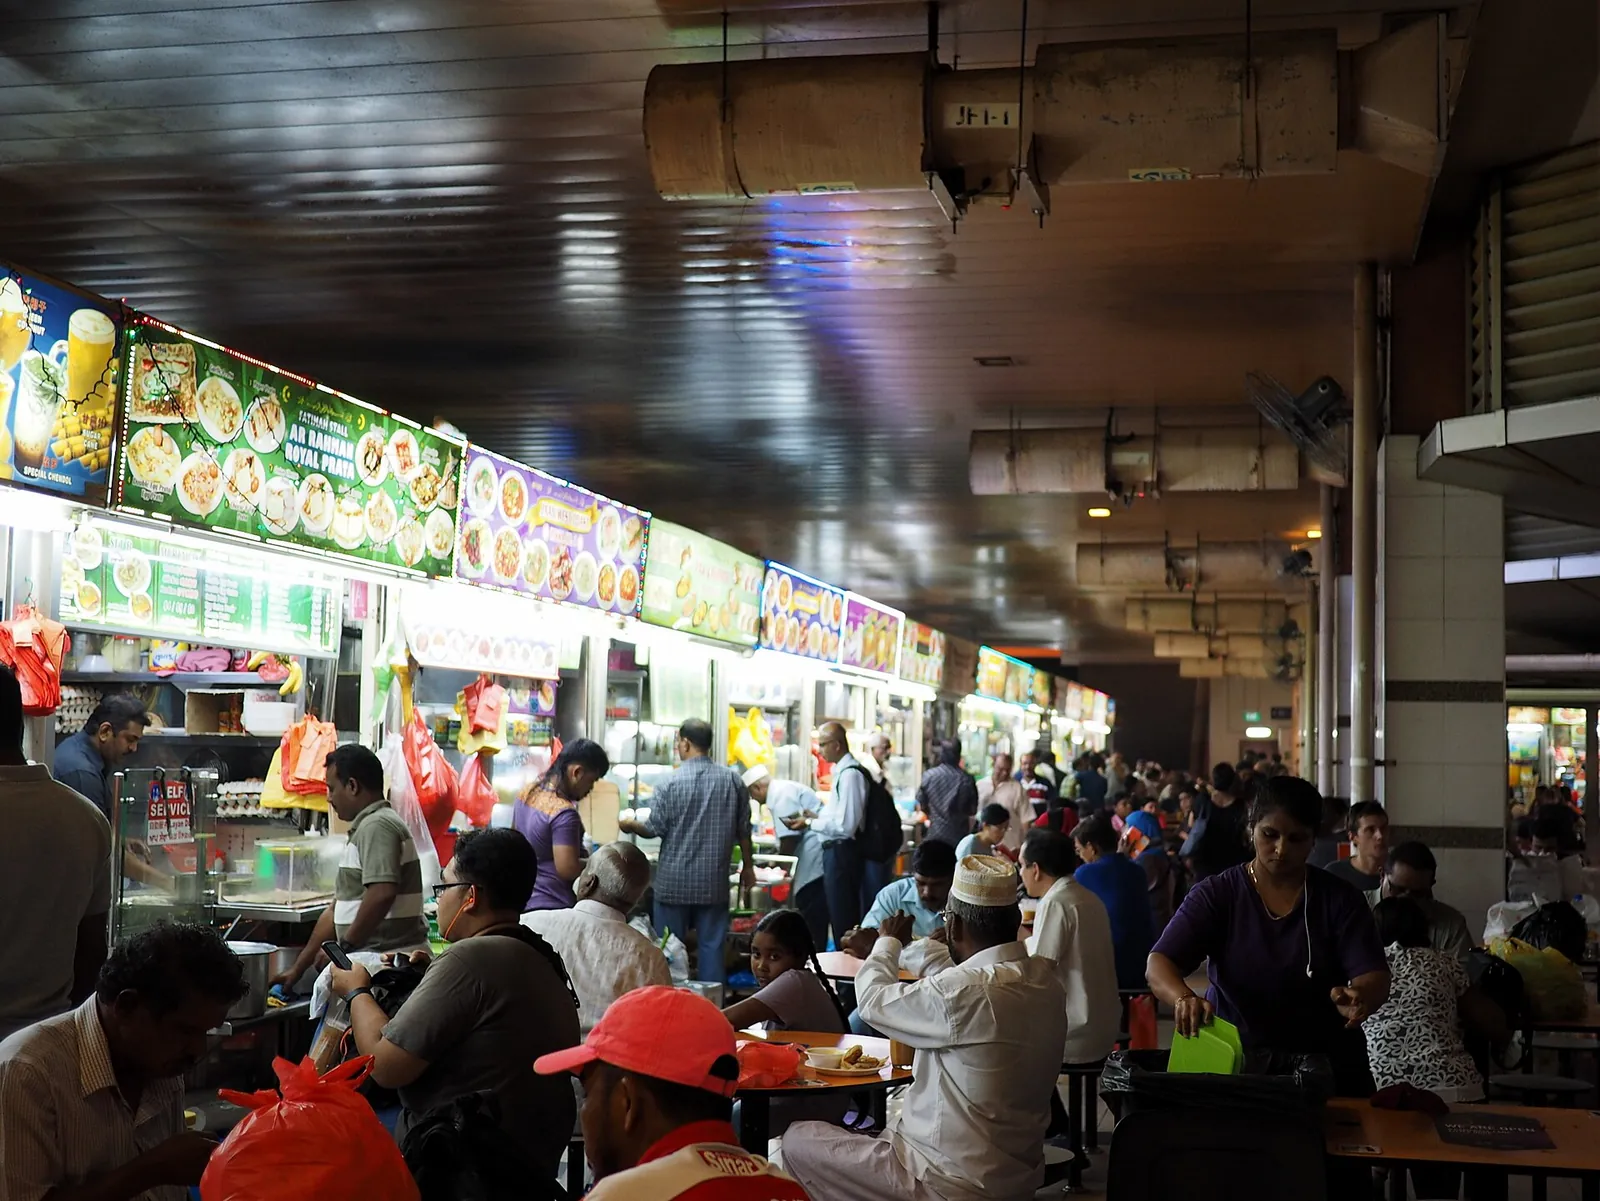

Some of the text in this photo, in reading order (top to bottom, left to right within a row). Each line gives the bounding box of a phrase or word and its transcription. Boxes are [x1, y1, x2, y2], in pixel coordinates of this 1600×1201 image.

[22, 310, 43, 325] GEEN
[82, 429, 101, 439] SUGAR
[298, 410, 349, 438] FATIMAH STALL
[83, 440, 98, 450] CANE
[289, 423, 355, 461] AR RAHMAN
[284, 442, 320, 470] ROYAL
[321, 454, 355, 480] PRATA
[23, 465, 72, 485] SPECIAL CHENDOL
[160, 785, 184, 799] ELF
[703, 1151, 756, 1176] Sinar
